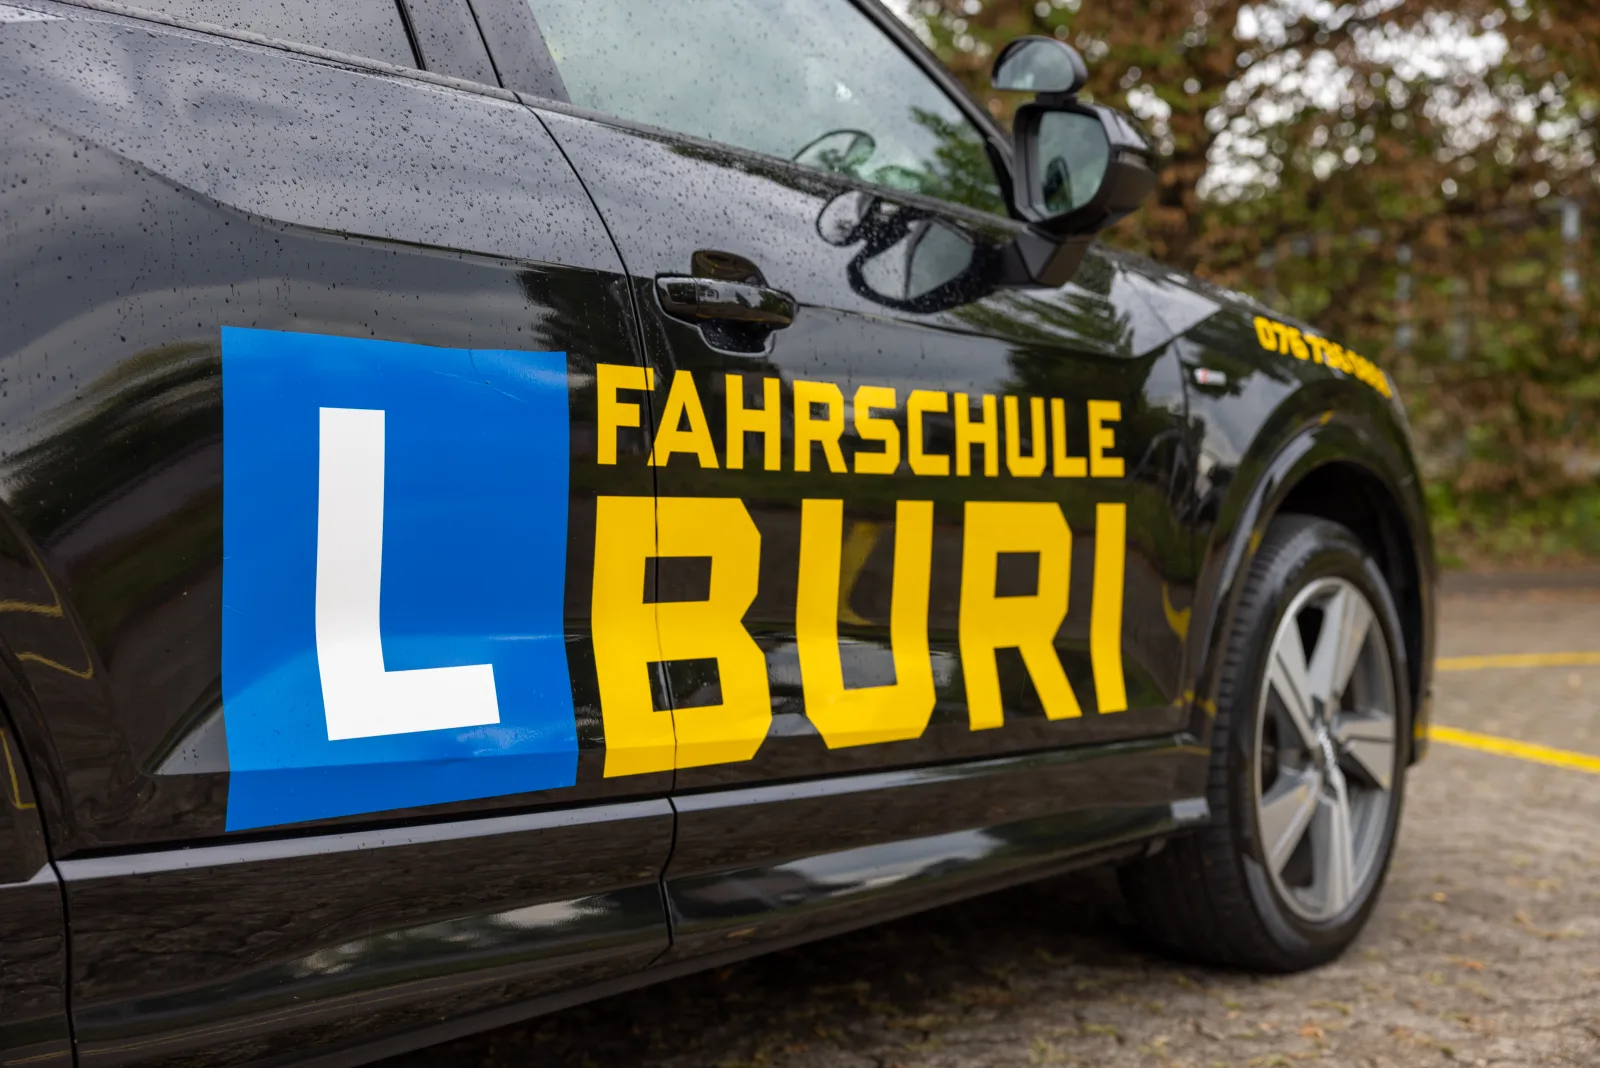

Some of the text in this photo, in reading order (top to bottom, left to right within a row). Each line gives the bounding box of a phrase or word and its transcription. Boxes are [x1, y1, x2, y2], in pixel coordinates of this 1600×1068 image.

[596, 363, 1125, 478] FAHRSCHULE
[1253, 316, 1310, 361] 076
[316, 407, 501, 741] L
[591, 495, 1127, 778] BURI
